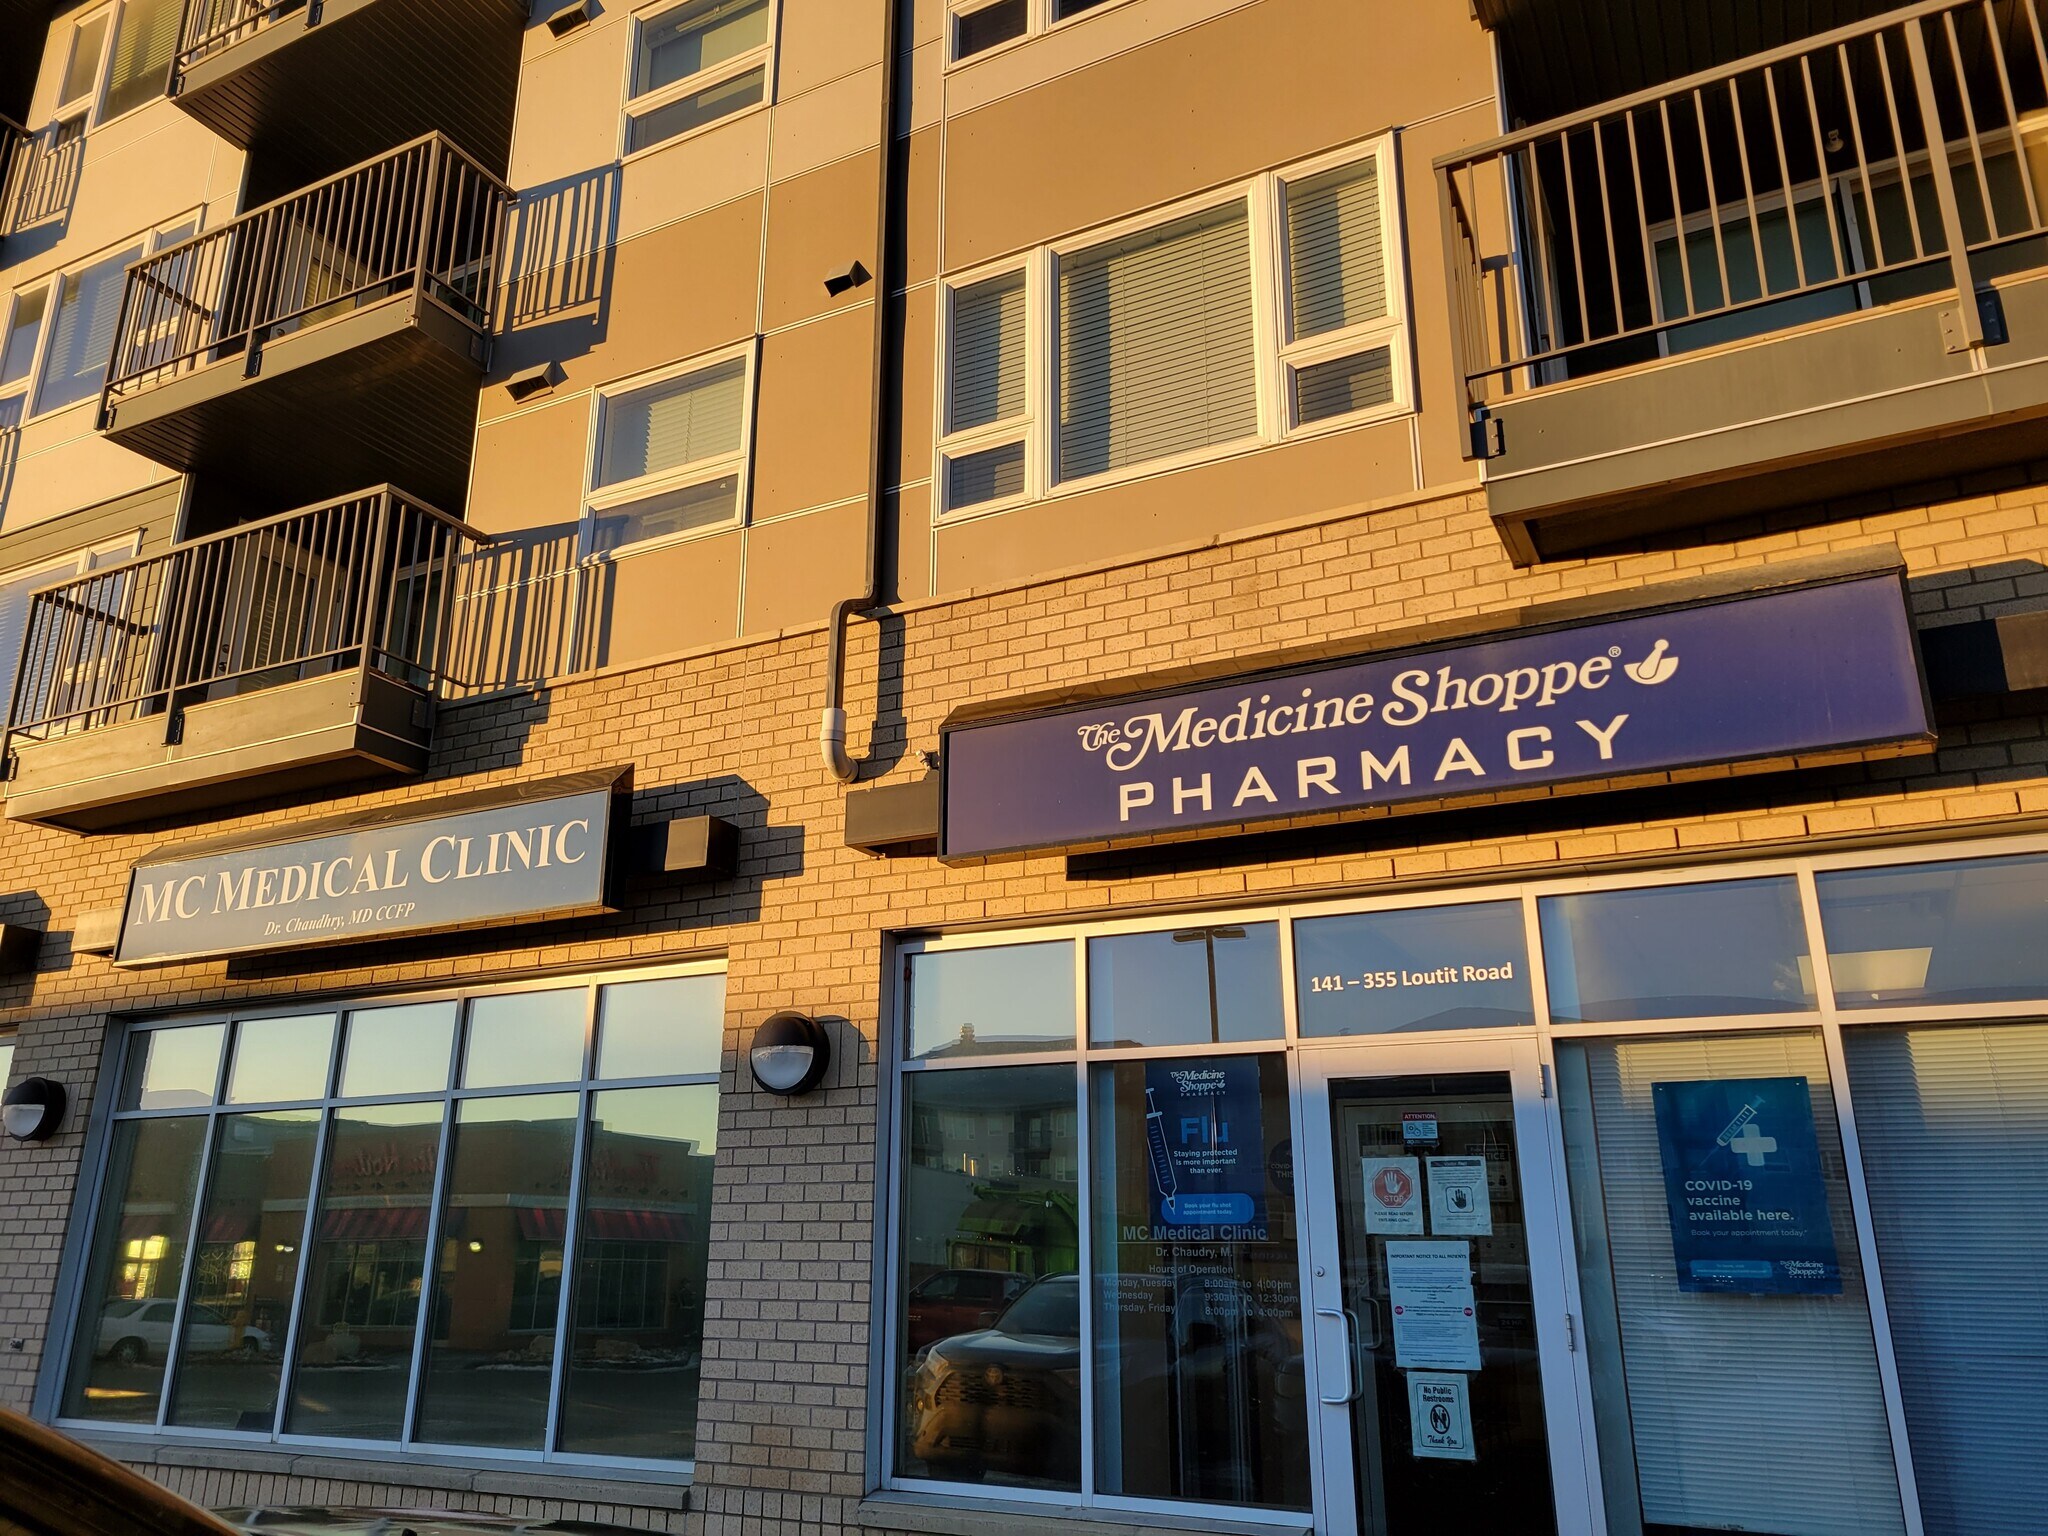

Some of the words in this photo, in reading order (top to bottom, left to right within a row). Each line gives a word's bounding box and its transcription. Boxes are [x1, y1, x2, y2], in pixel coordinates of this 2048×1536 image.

[1077, 720, 1120, 751] The
[1106, 688, 1374, 771] Medicine
[1118, 714, 1629, 821] PHARMACY
[133, 875, 206, 926] MC
[212, 849, 408, 915] MEDICAL
[421, 818, 589, 884] CLINIC
[264, 921, 282, 937] Dr.
[285, 914, 345, 935] Chaudhry,
[348, 908, 372, 925] MD
[375, 902, 416, 922] CCFP
[1311, 975, 1344, 992] 141
[1363, 971, 1397, 989] 355
[1402, 967, 1458, 986] Loutit
[1462, 962, 1513, 982] Road
[1176, 1069, 1225, 1084] Medicine
[1180, 1115, 1229, 1144] Flu
[1202, 1148, 1238, 1157] protected
[1202, 1158, 1237, 1166] important
[1684, 1180, 1753, 1191] COVID-19
[1383, 1195, 1403, 1203] STOP
[1686, 1194, 1741, 1206] vaccine
[1689, 1209, 1753, 1221] available
[1757, 1209, 1795, 1221] here.
[1123, 1226, 1148, 1241] MC
[1153, 1225, 1214, 1241] Medical
[1220, 1225, 1267, 1241] Clinic
[1731, 1229, 1779, 1238] appointment
[1156, 1248, 1169, 1257] Dr.
[1172, 1247, 1218, 1260] Chaudry,
[1149, 1265, 1176, 1273] Hours
[1178, 1265, 1187, 1273] of
[1189, 1265, 1233, 1275] Operation
[1103, 1290, 1153, 1301] Wednesday
[1258, 1293, 1298, 1305] 12:30pm
[1423, 1386, 1431, 1394] No
[1432, 1386, 1452, 1394] Public
[1423, 1395, 1455, 1403] Restrooms
